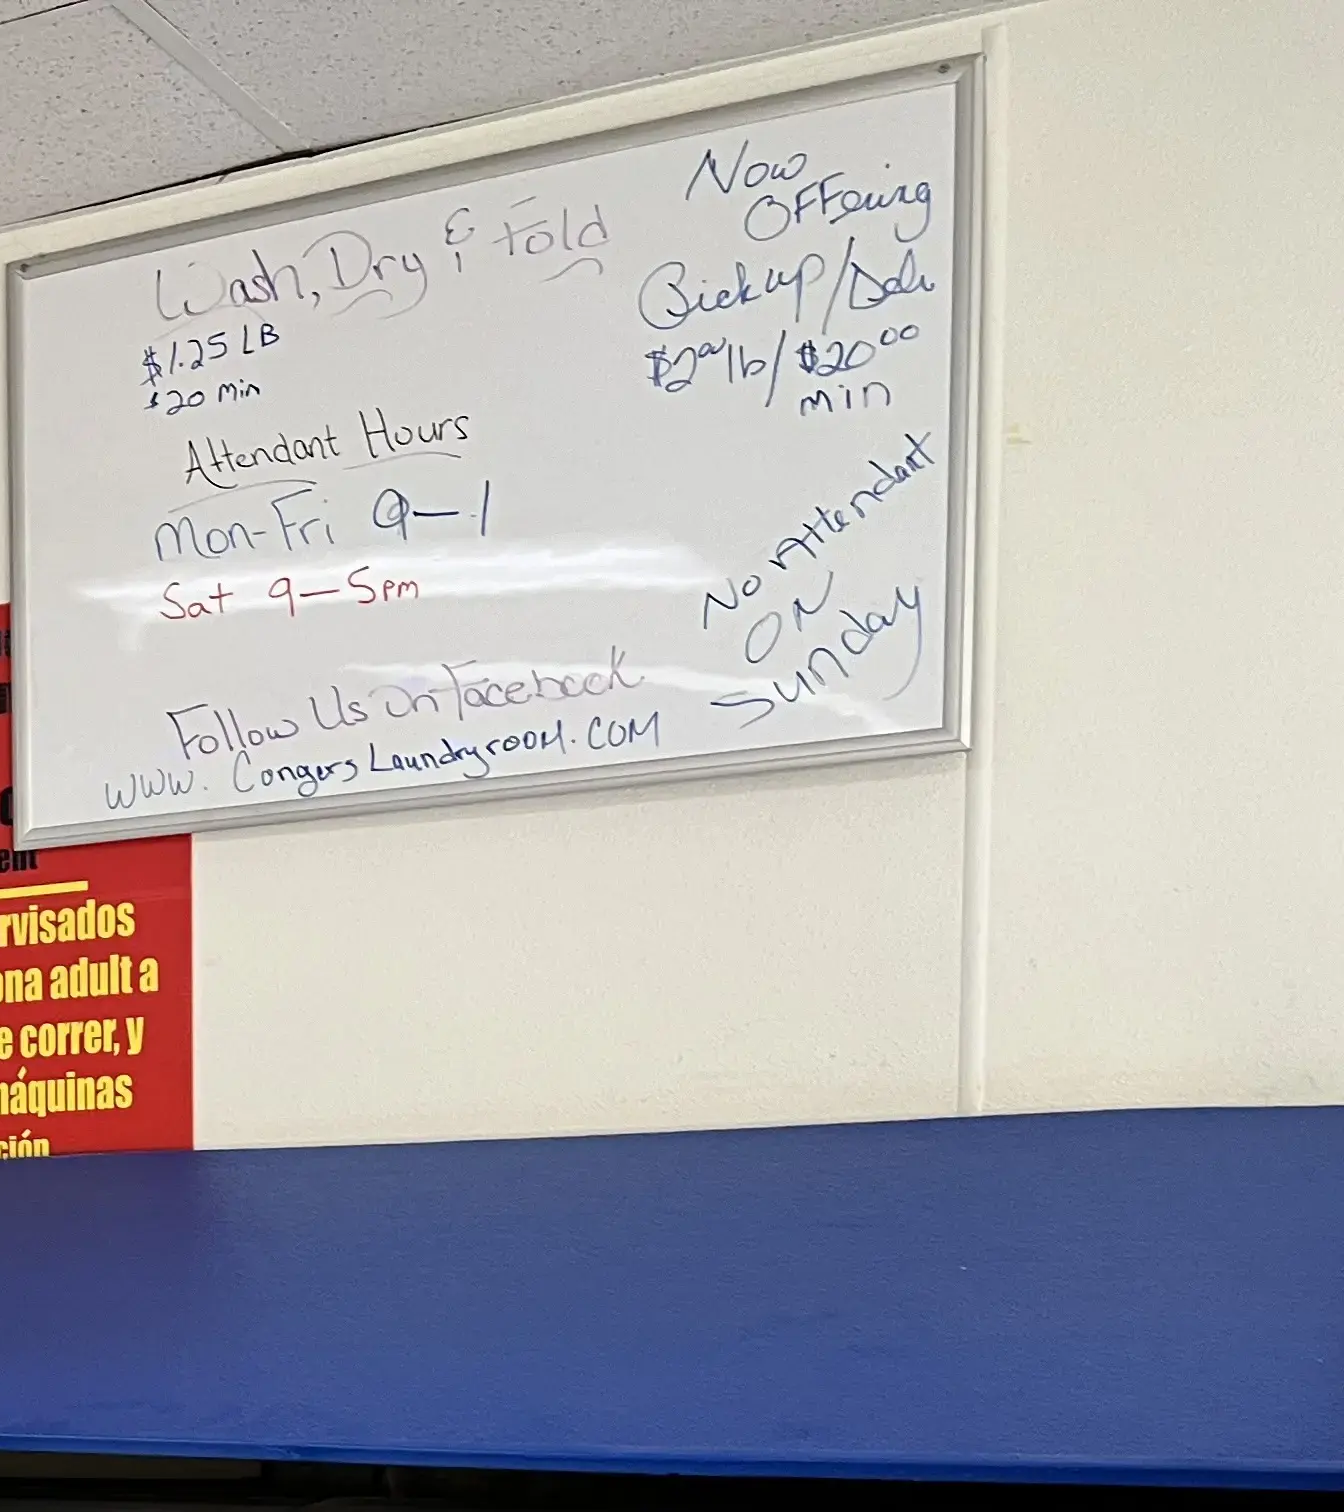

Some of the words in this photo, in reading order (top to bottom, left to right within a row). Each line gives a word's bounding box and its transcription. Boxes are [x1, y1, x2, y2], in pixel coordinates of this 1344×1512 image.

[685, 138, 808, 201] Now
[155, 247, 322, 321] Wash,
[302, 229, 429, 320] Dry
[492, 195, 613, 258] Fold
[139, 331, 228, 387] $1.25
[242, 323, 281, 355] LB
[144, 390, 205, 416] $20
[799, 380, 892, 417] min
[185, 424, 341, 490] Attendant
[358, 407, 471, 460] Hours
[702, 574, 763, 631] No
[767, 431, 937, 571] Attendant
[159, 582, 235, 621] Sat
[709, 584, 925, 731] Sunday
[166, 703, 301, 761] Follow
[308, 685, 370, 731] Us
[441, 644, 647, 724] Facebook
[49, 954, 134, 1000] adult
[137, 956, 161, 994] a
[18, 1017, 122, 1062] correr,
[125, 1014, 146, 1056] y
